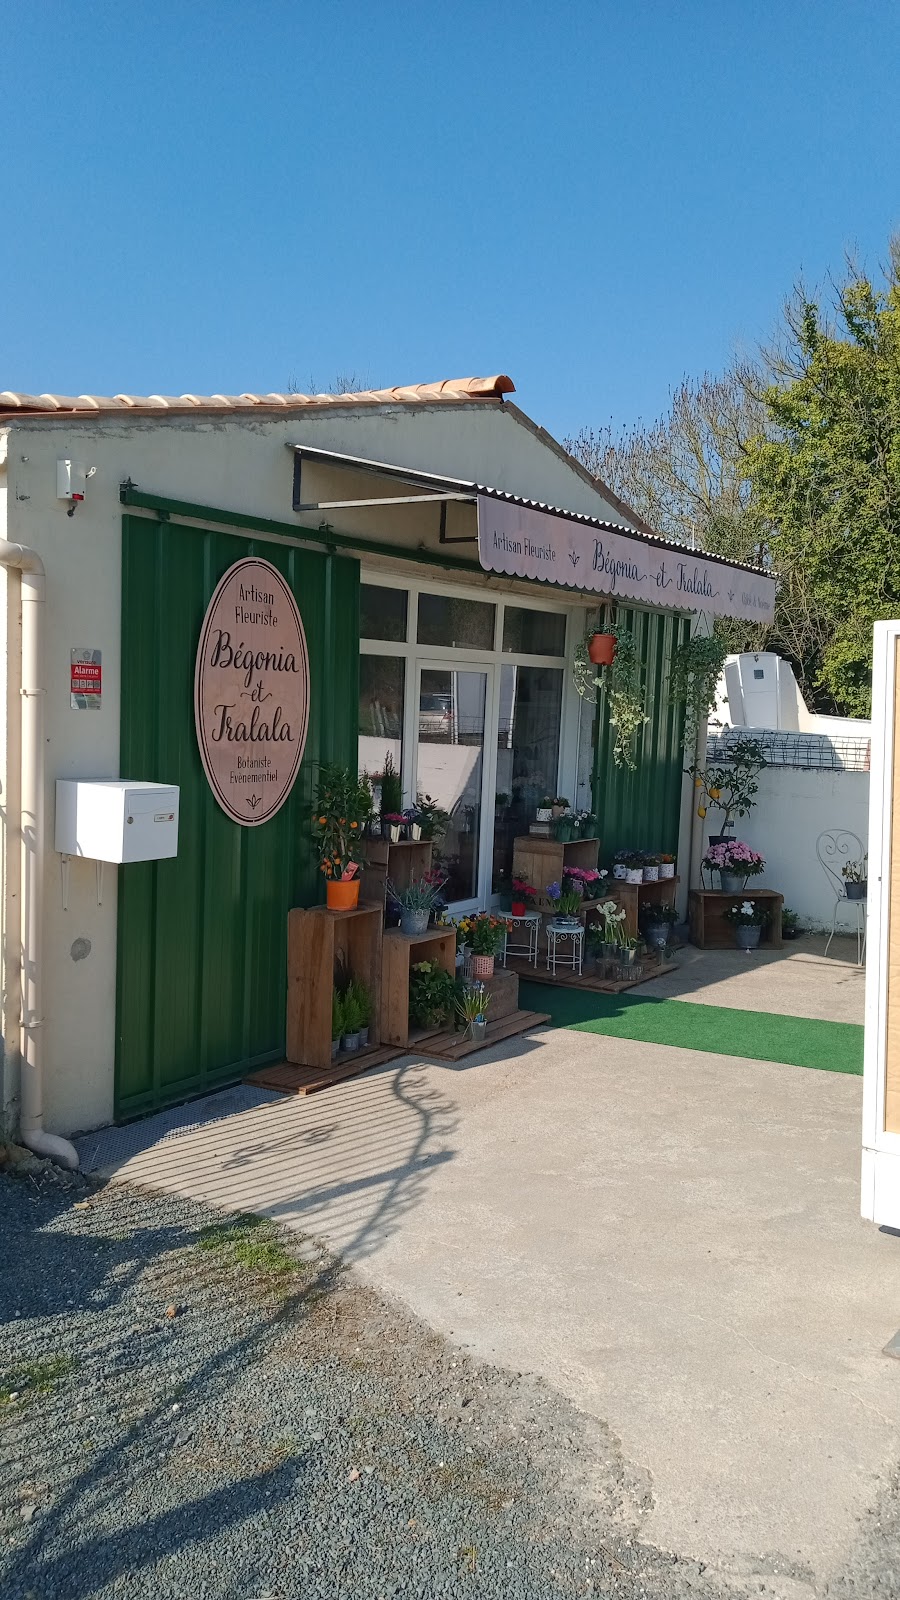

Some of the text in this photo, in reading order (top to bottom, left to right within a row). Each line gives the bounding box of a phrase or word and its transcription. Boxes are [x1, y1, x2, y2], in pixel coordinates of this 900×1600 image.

[493, 530, 720, 598] Artisan Fleuriste Bégonia et Tralala
[239, 583, 274, 605] Artisan
[235, 605, 278, 627] Fleuriste
[210, 629, 299, 688] Bégonia
[74, 665, 99, 676] Alarme
[240, 680, 273, 702] et
[211, 703, 295, 742] Tralala
[237, 755, 272, 769] Botaniste
